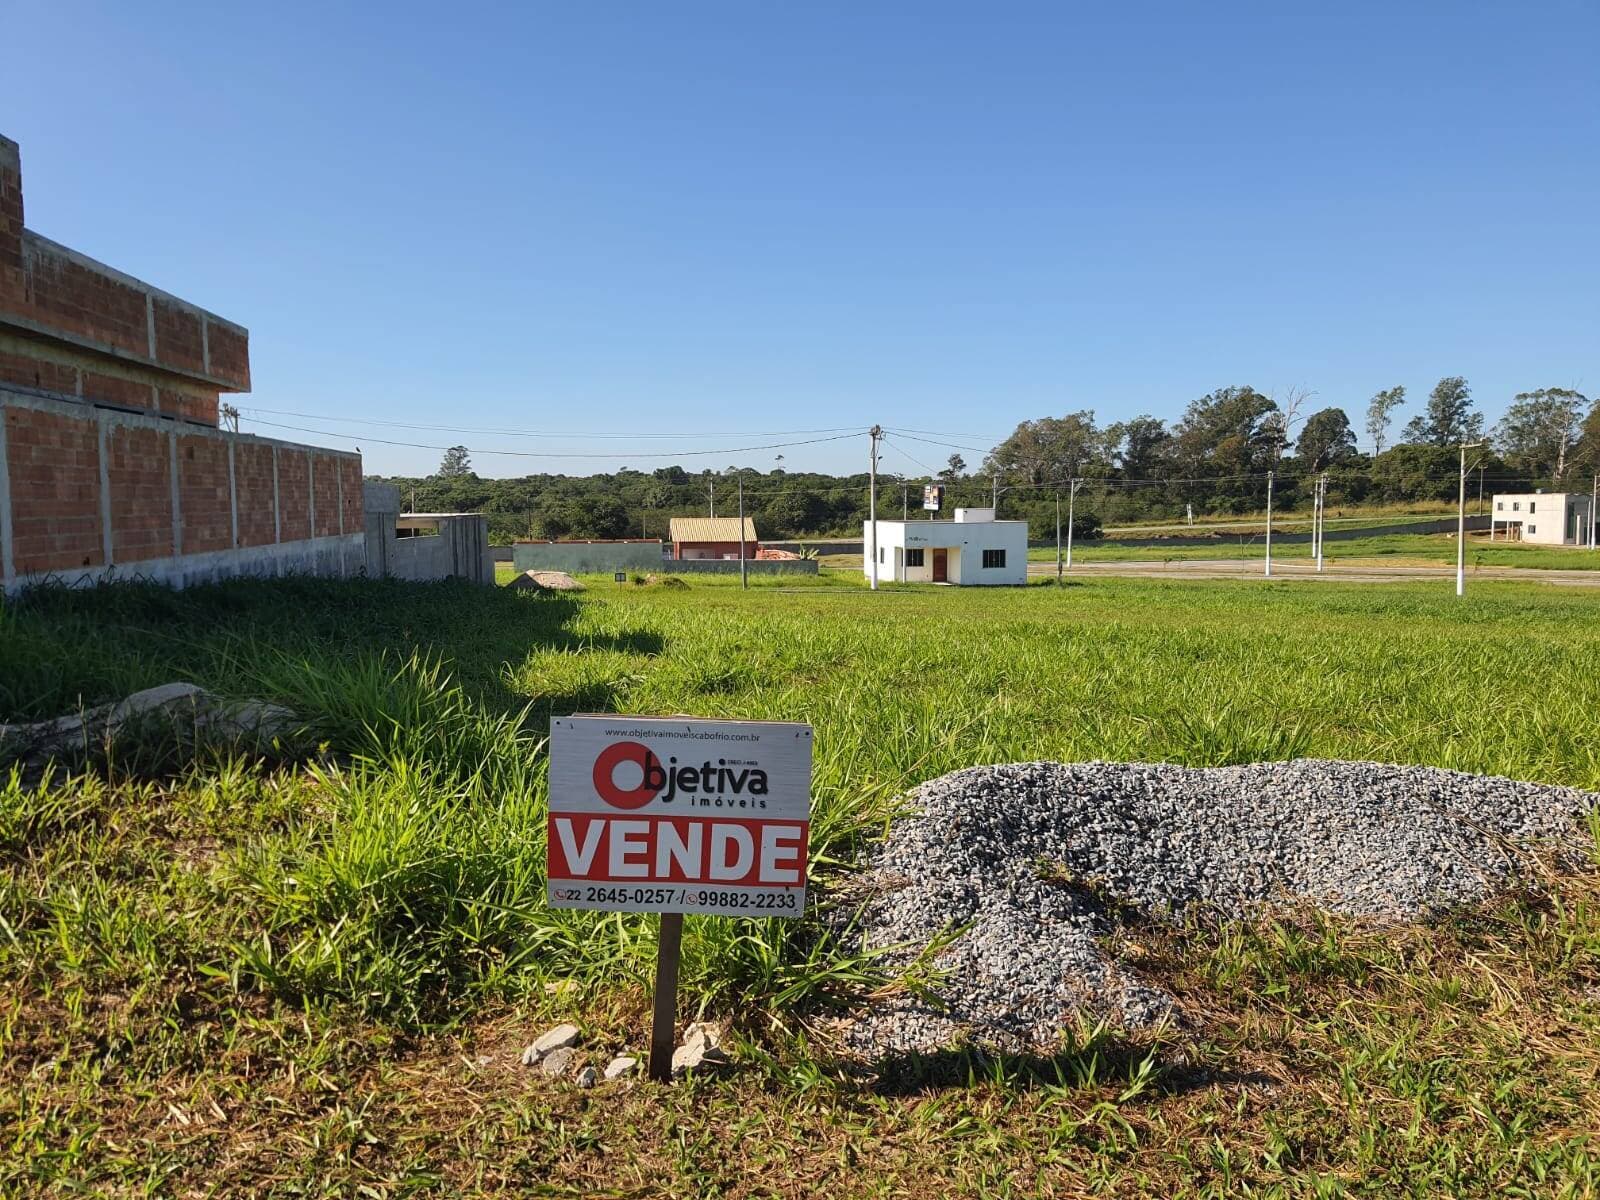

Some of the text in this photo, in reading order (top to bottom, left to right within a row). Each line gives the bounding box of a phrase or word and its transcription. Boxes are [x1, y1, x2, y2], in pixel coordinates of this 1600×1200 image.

[605, 728, 760, 742] www.objetivaimoveiscabofrio.com.br
[592, 741, 769, 810] Objetiva
[691, 796, 766, 809] imóveis
[555, 818, 802, 883] VENDE
[566, 889, 581, 901] 22
[587, 887, 675, 904] 2645-0257
[698, 890, 796, 909] 99882-2233
